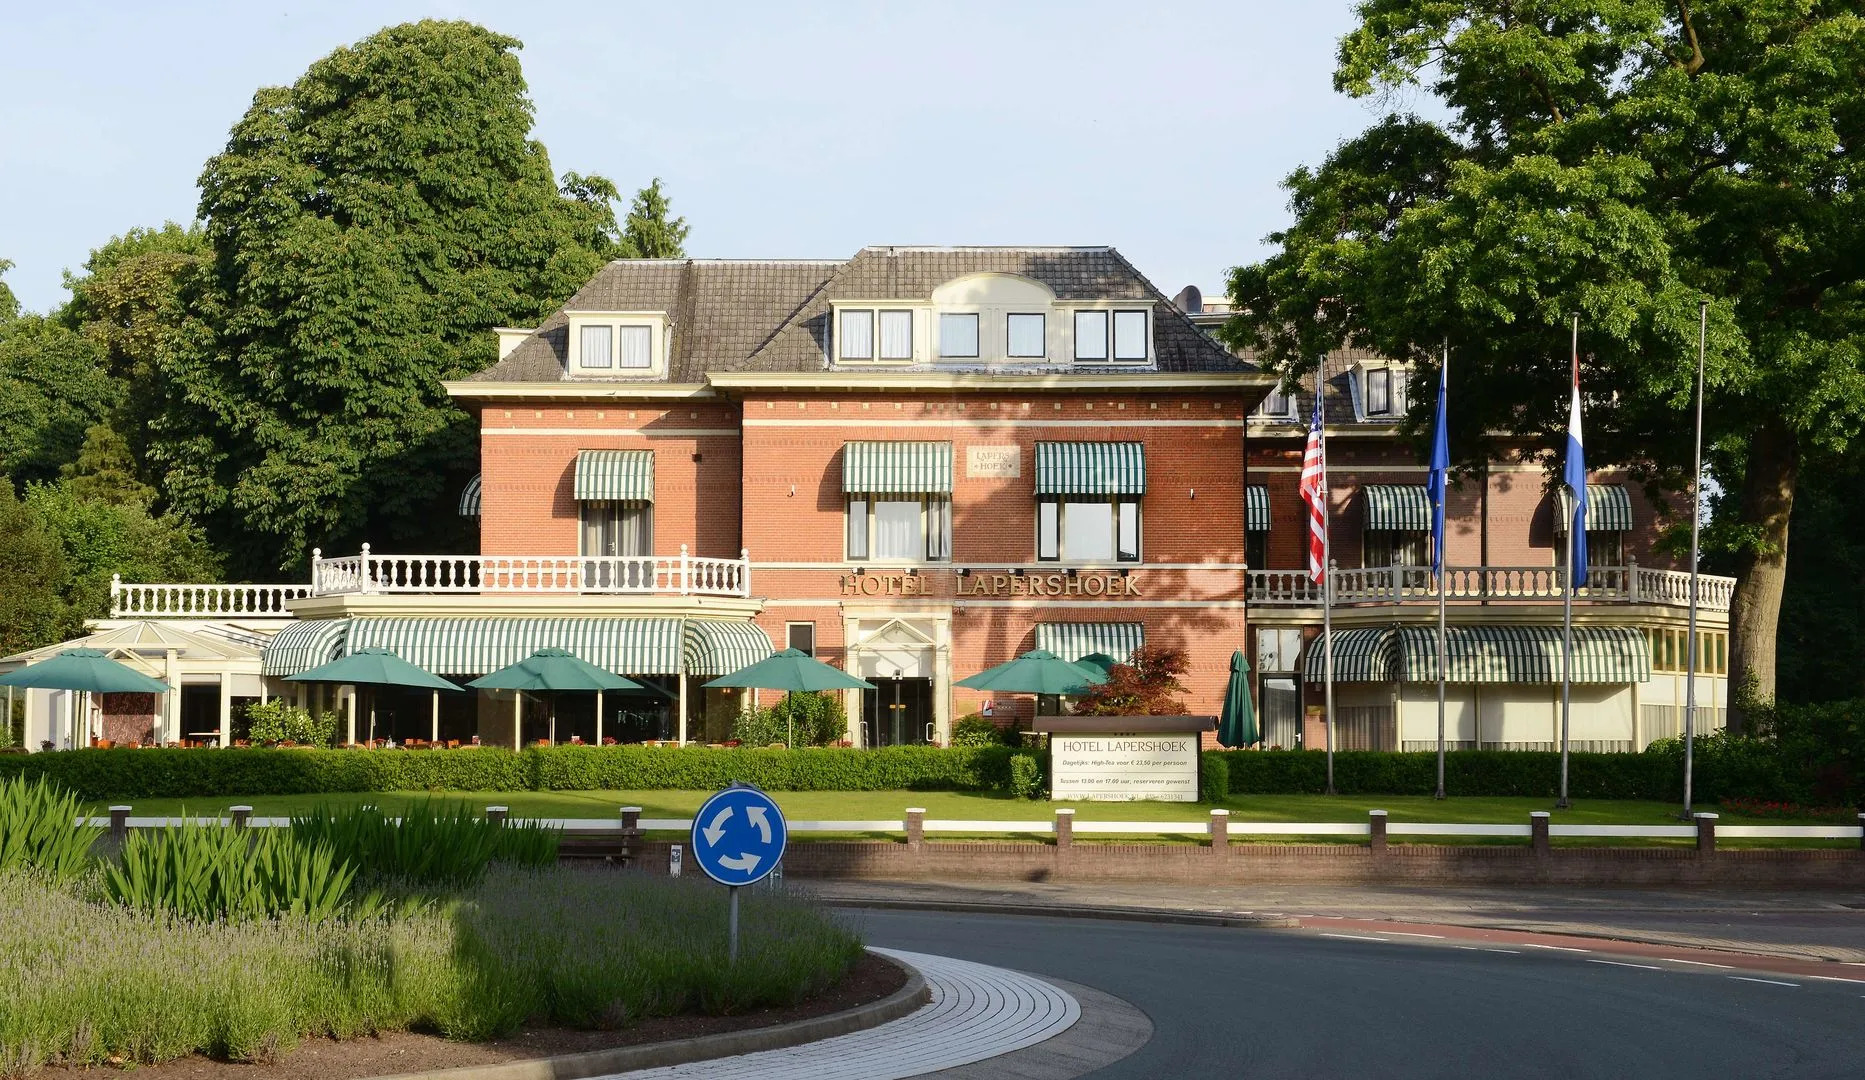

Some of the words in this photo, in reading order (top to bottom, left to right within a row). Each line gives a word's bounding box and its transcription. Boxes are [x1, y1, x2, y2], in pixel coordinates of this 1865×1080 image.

[976, 451, 1010, 462] LAPERS
[980, 462, 1007, 470] HOEK
[840, 574, 935, 596] HOTEL
[955, 574, 1143, 597] LAPERSHOEK
[1063, 741, 1103, 752] HOTEL
[1107, 741, 1187, 752] LAPERSHOEK
[1091, 759, 1115, 767] High-Tea
